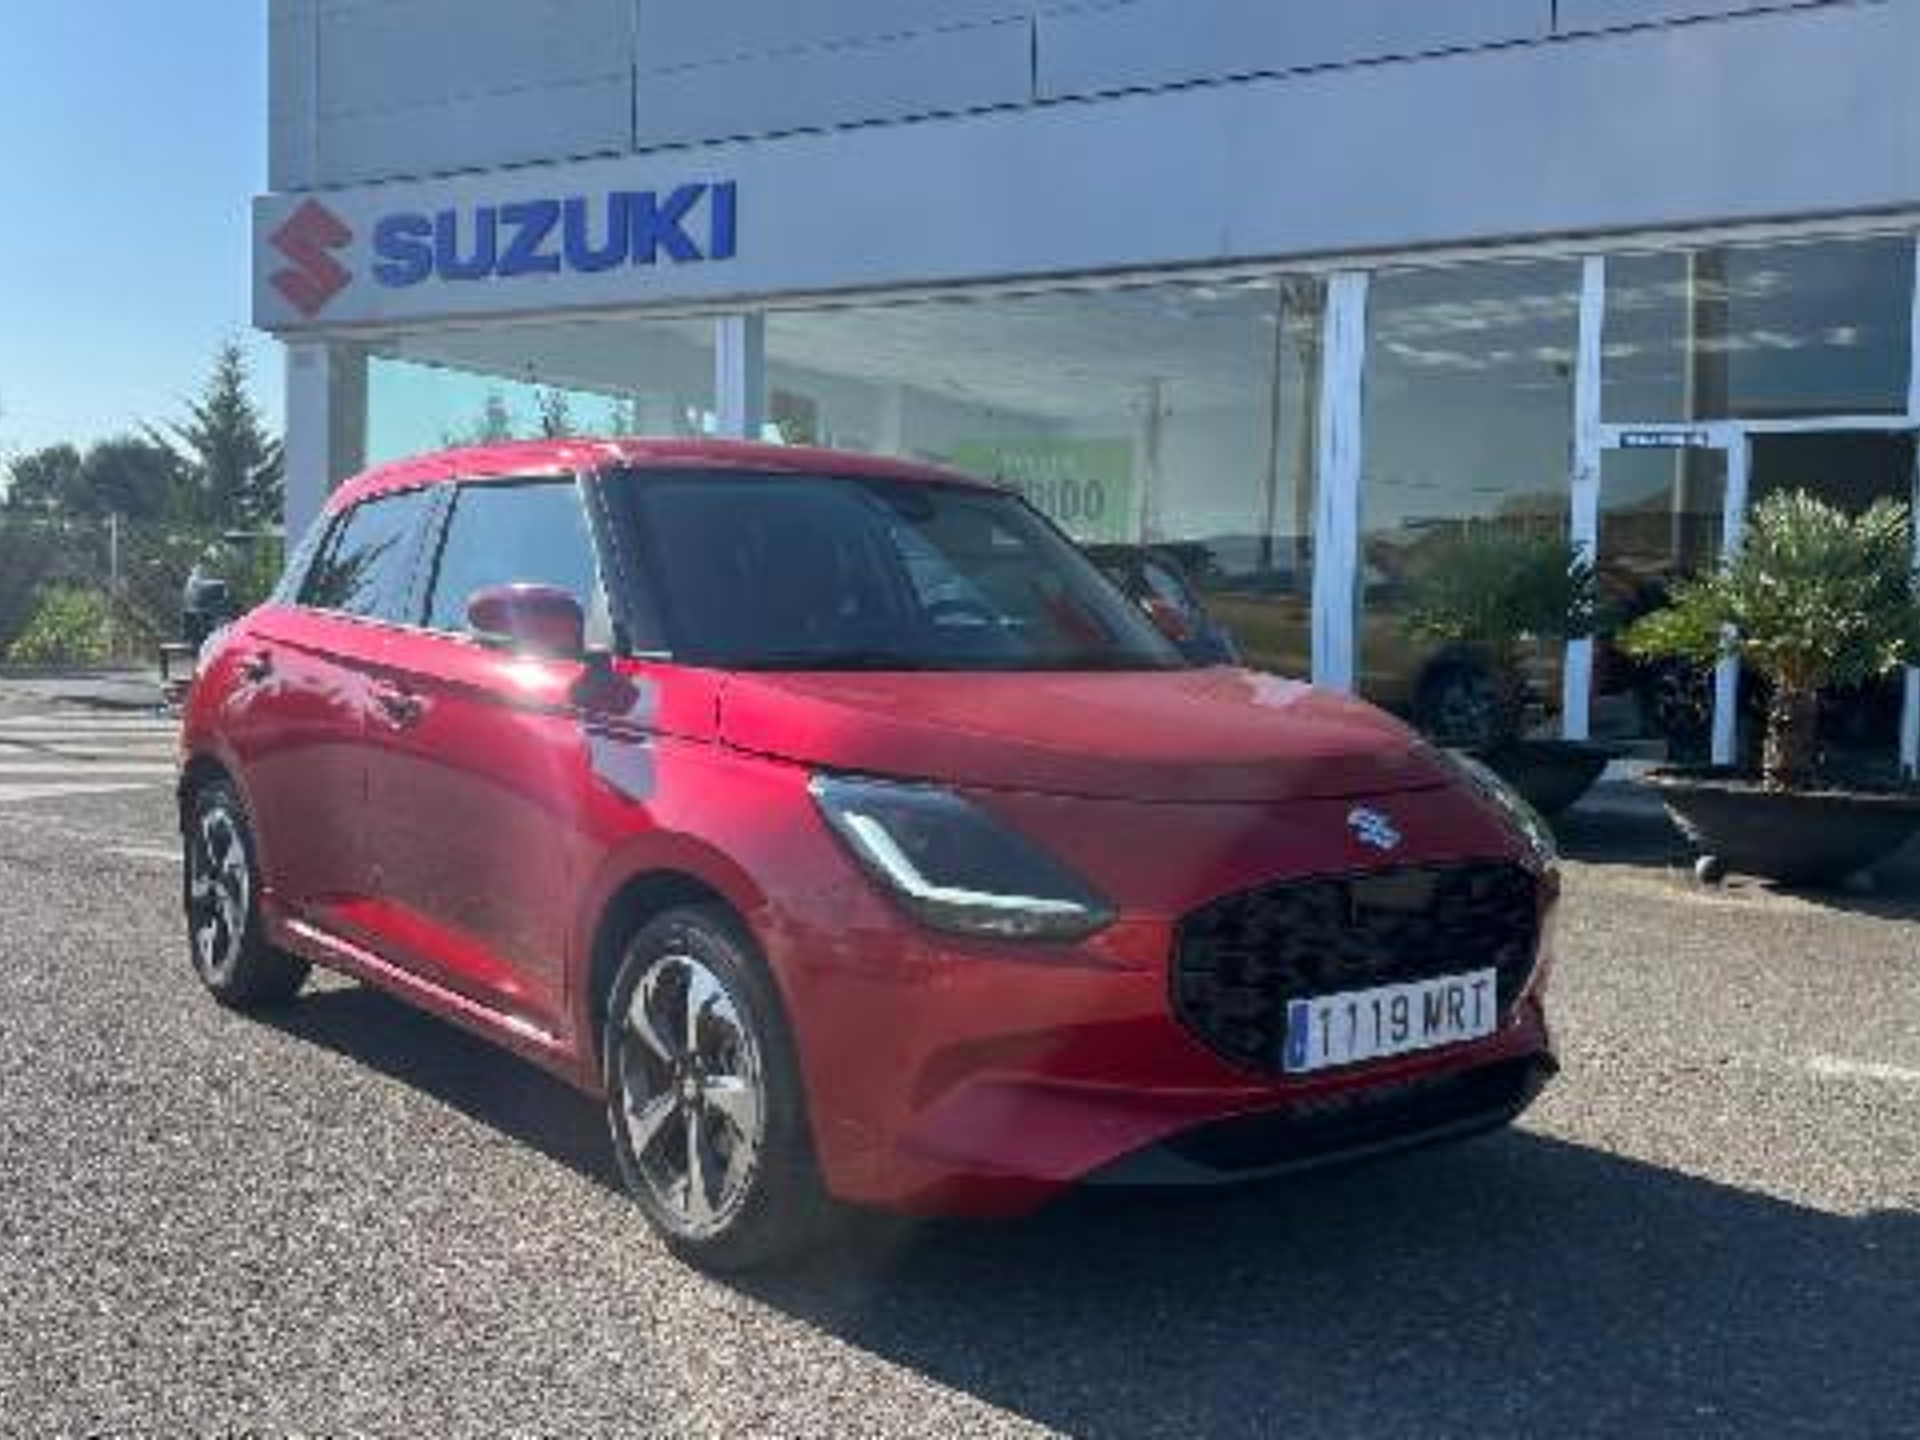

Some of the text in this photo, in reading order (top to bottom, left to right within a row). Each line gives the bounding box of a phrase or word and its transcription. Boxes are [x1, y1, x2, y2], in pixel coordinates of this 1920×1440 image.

[372, 180, 737, 288] SUZUKI
[1319, 977, 1488, 1057] 1119 MRT
